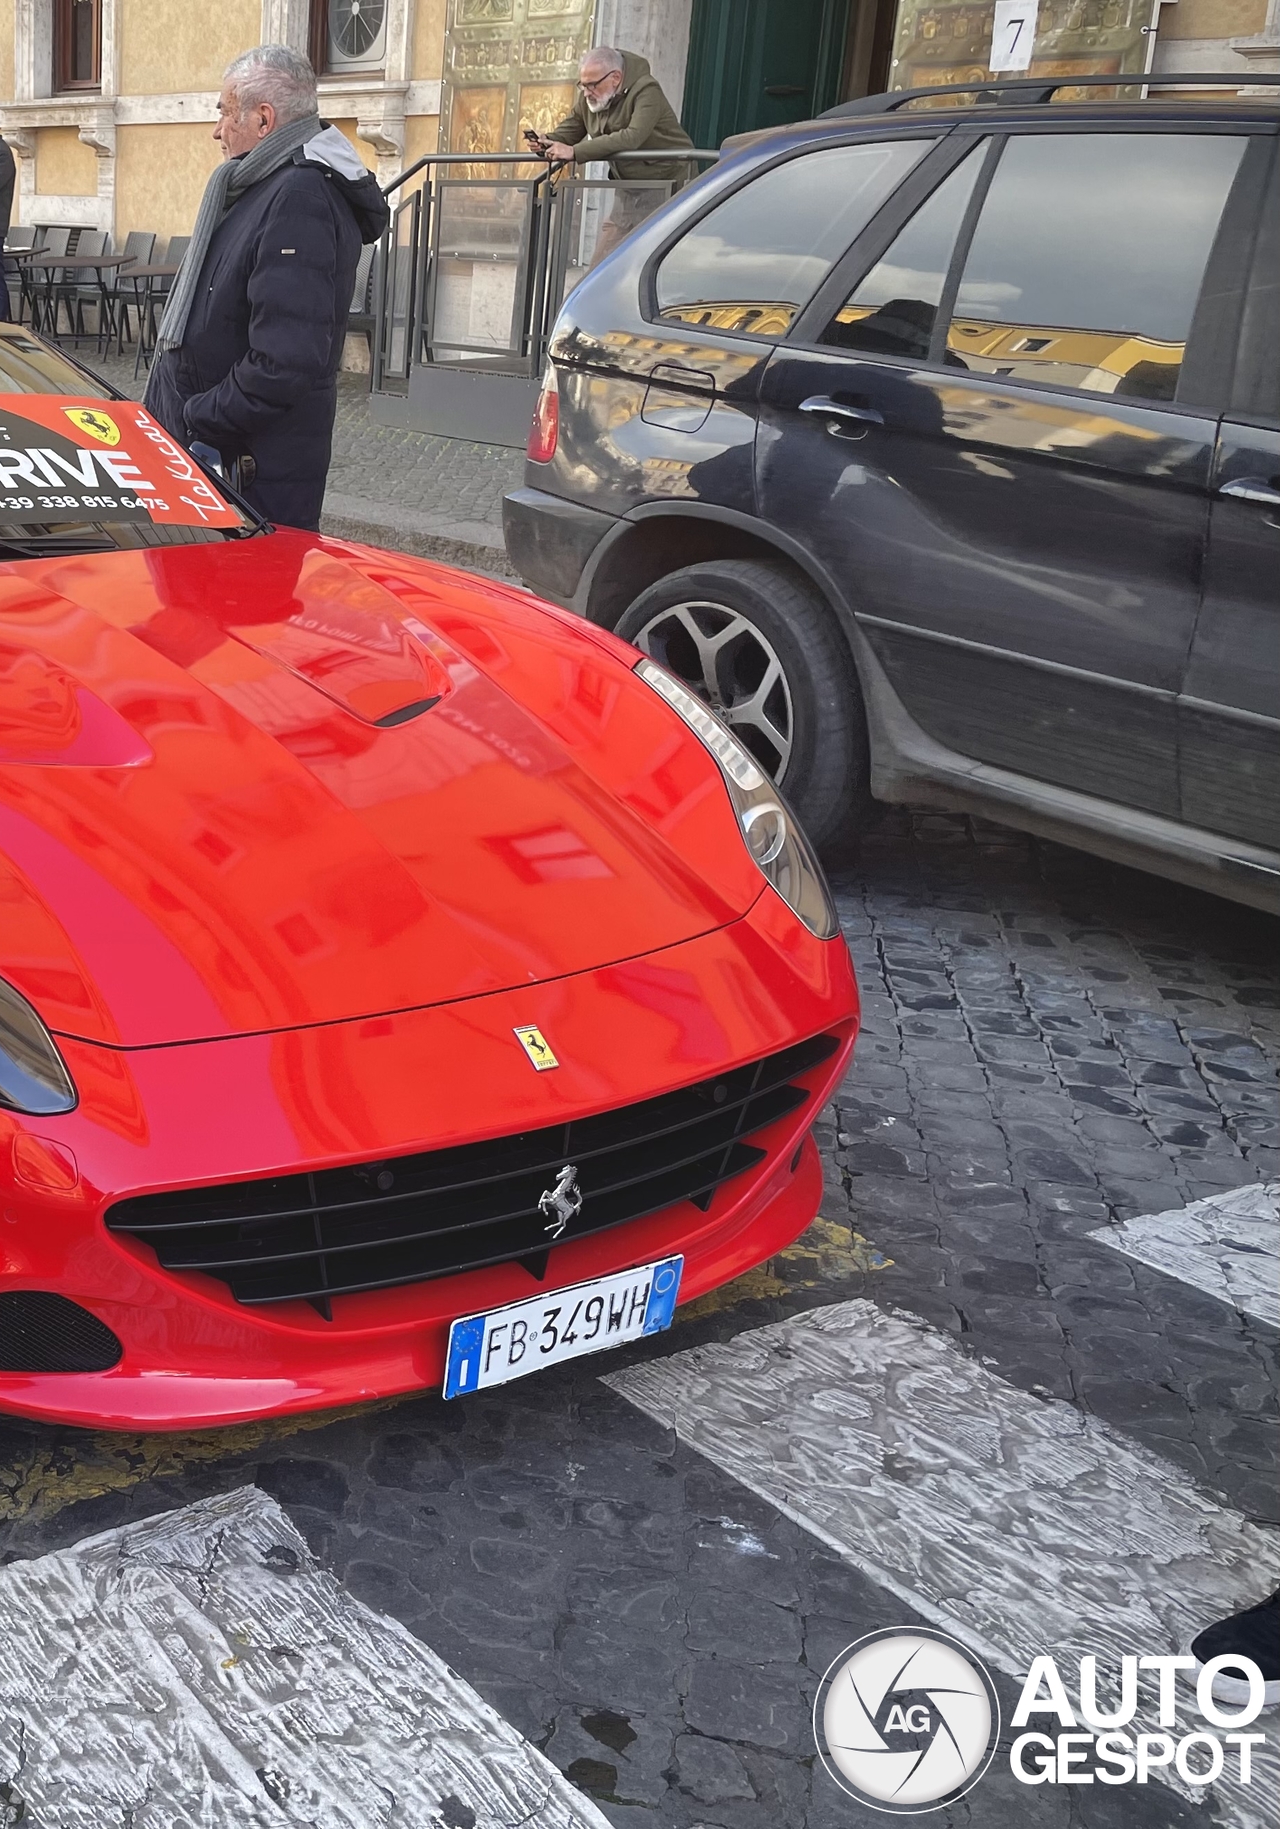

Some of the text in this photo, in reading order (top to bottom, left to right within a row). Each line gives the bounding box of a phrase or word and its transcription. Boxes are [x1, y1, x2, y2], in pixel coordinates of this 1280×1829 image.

[1006, 19, 1025, 54] 7
[37, 495, 80, 509] 338
[80, 495, 118, 509] 815
[120, 496, 170, 511] 6475
[484, 1320, 528, 1373] FB
[540, 1282, 651, 1354] 349WH
